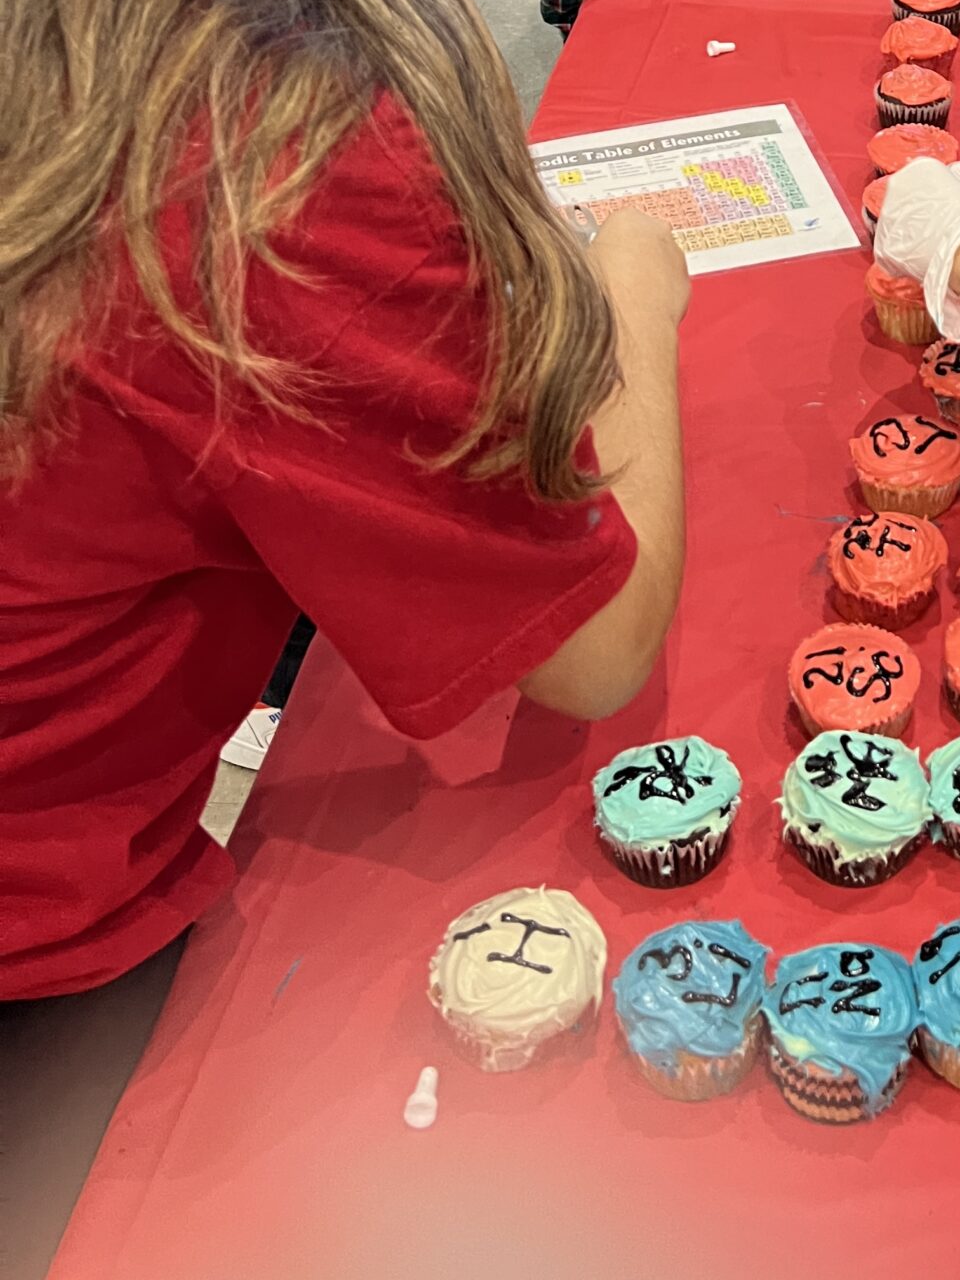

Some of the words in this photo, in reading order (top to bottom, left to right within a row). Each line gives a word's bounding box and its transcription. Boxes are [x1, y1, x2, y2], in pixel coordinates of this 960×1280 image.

[582, 147, 633, 162] Table
[638, 140, 656, 153] of
[662, 128, 741, 148] Elements
[803, 646, 848, 689] 21
[453, 922, 492, 942] 1
[486, 912, 572, 975] H
[637, 944, 693, 981] 3
[681, 938, 752, 1007] Li
[829, 949, 883, 1016] Na
